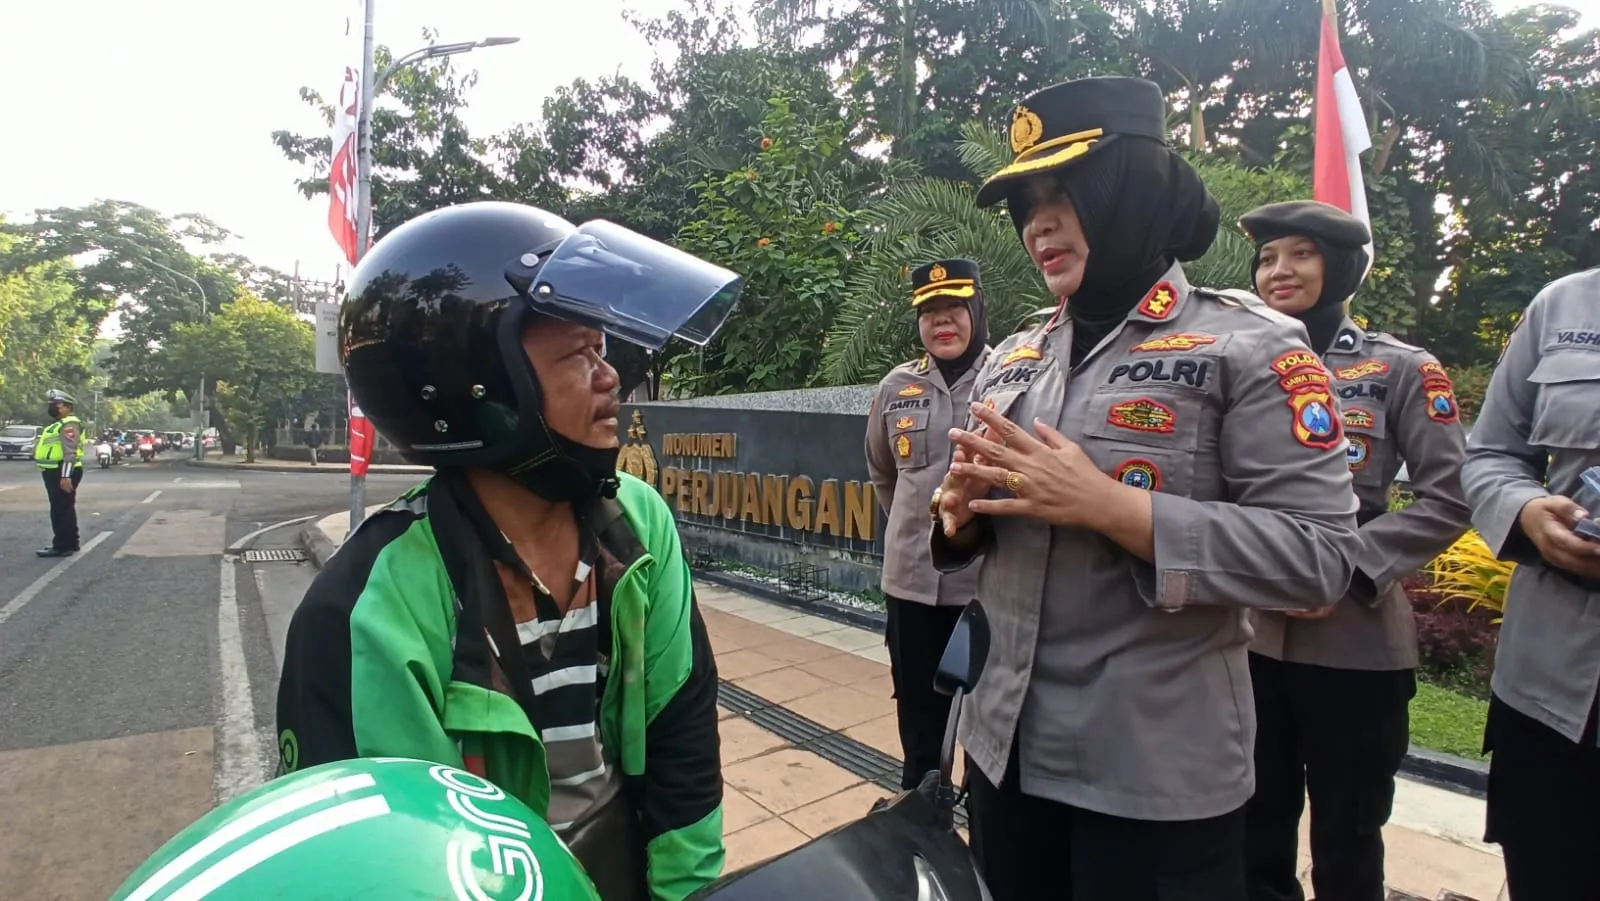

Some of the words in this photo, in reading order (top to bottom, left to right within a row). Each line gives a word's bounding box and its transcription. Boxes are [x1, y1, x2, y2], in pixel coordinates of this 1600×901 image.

[1557, 331, 1600, 346] YASH
[1108, 359, 1208, 387] POLRI
[1336, 383, 1388, 401] OLRI
[663, 433, 736, 458] MONUMEN
[662, 466, 875, 541] PERJUANGAN
